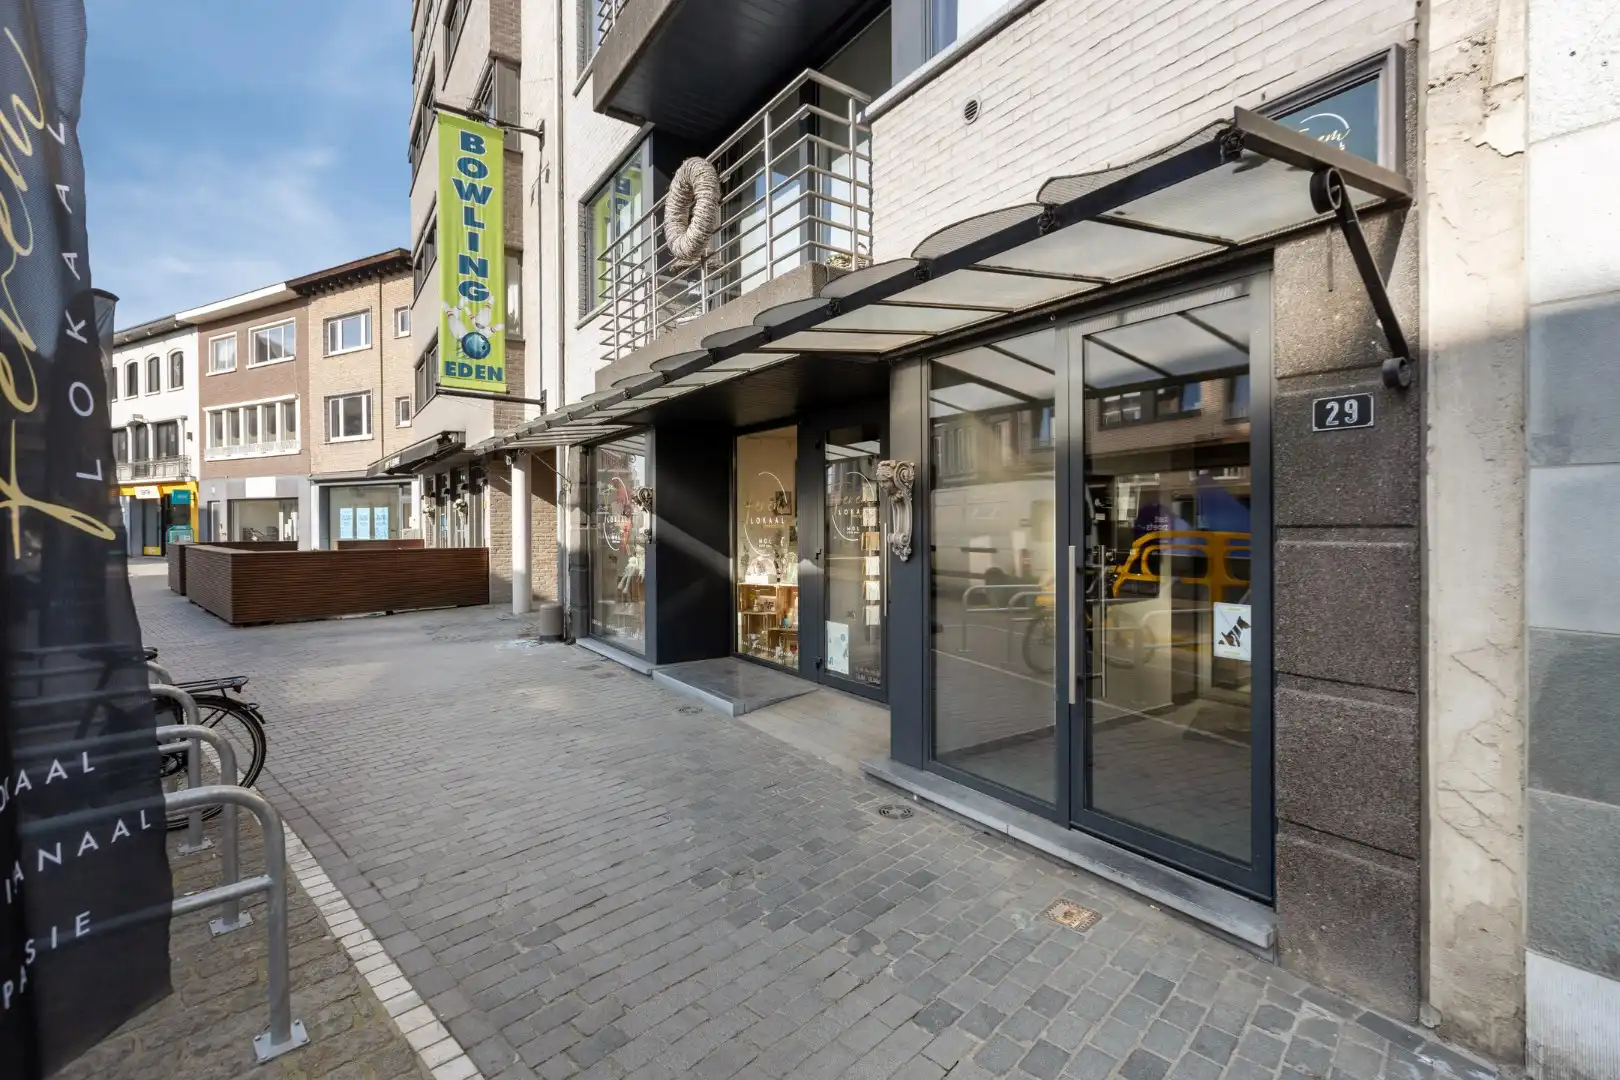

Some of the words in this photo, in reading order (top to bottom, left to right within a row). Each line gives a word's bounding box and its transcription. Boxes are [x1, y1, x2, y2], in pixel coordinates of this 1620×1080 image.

[452, 130, 494, 302] BOWLING
[47, 122, 104, 482] LOKAAL
[444, 360, 504, 382] EDEN
[1325, 398, 1359, 426] 29
[750, 517, 785, 525] LOKAAL
